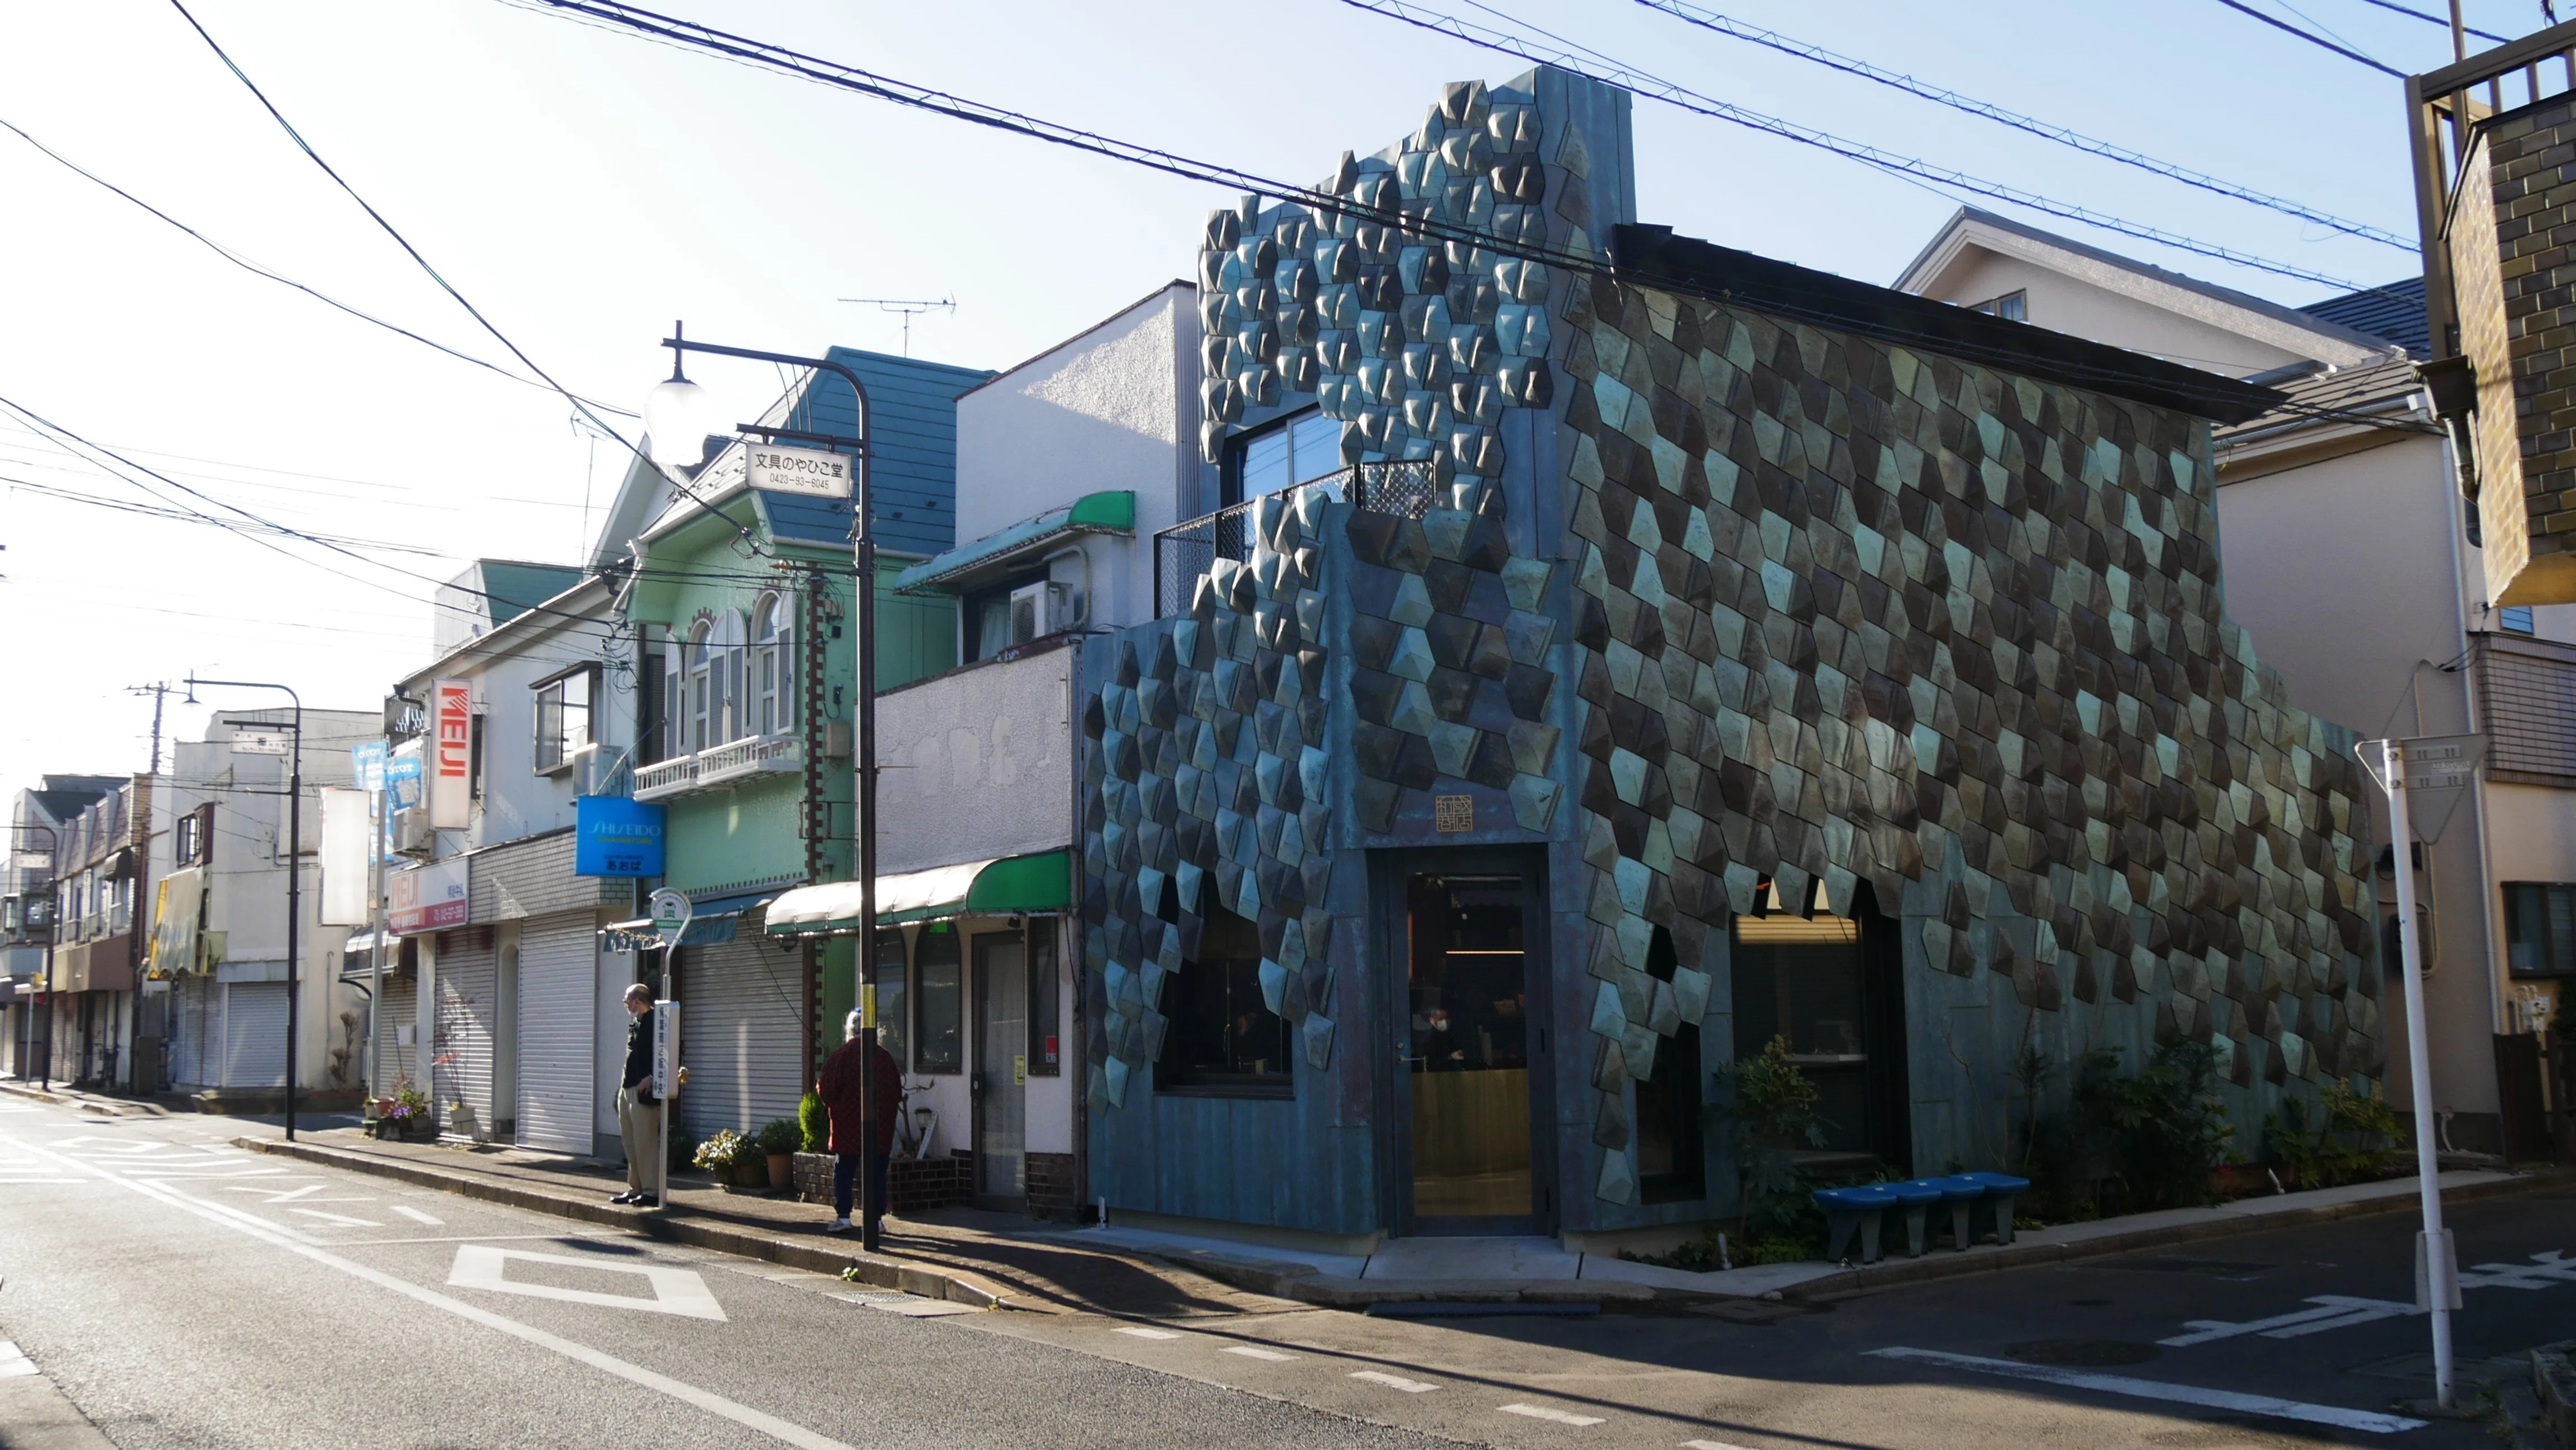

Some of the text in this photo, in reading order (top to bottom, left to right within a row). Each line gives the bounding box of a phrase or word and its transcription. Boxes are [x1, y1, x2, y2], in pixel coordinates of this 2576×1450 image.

[755, 452, 843, 478] 文具のやひこ堂
[770, 472, 829, 490] 0423-93-6045
[440, 687, 468, 777] MEIJI
[587, 821, 661, 837] SHISEIDO
[606, 860, 641, 871] あおば
[391, 874, 419, 910] MEIJI
